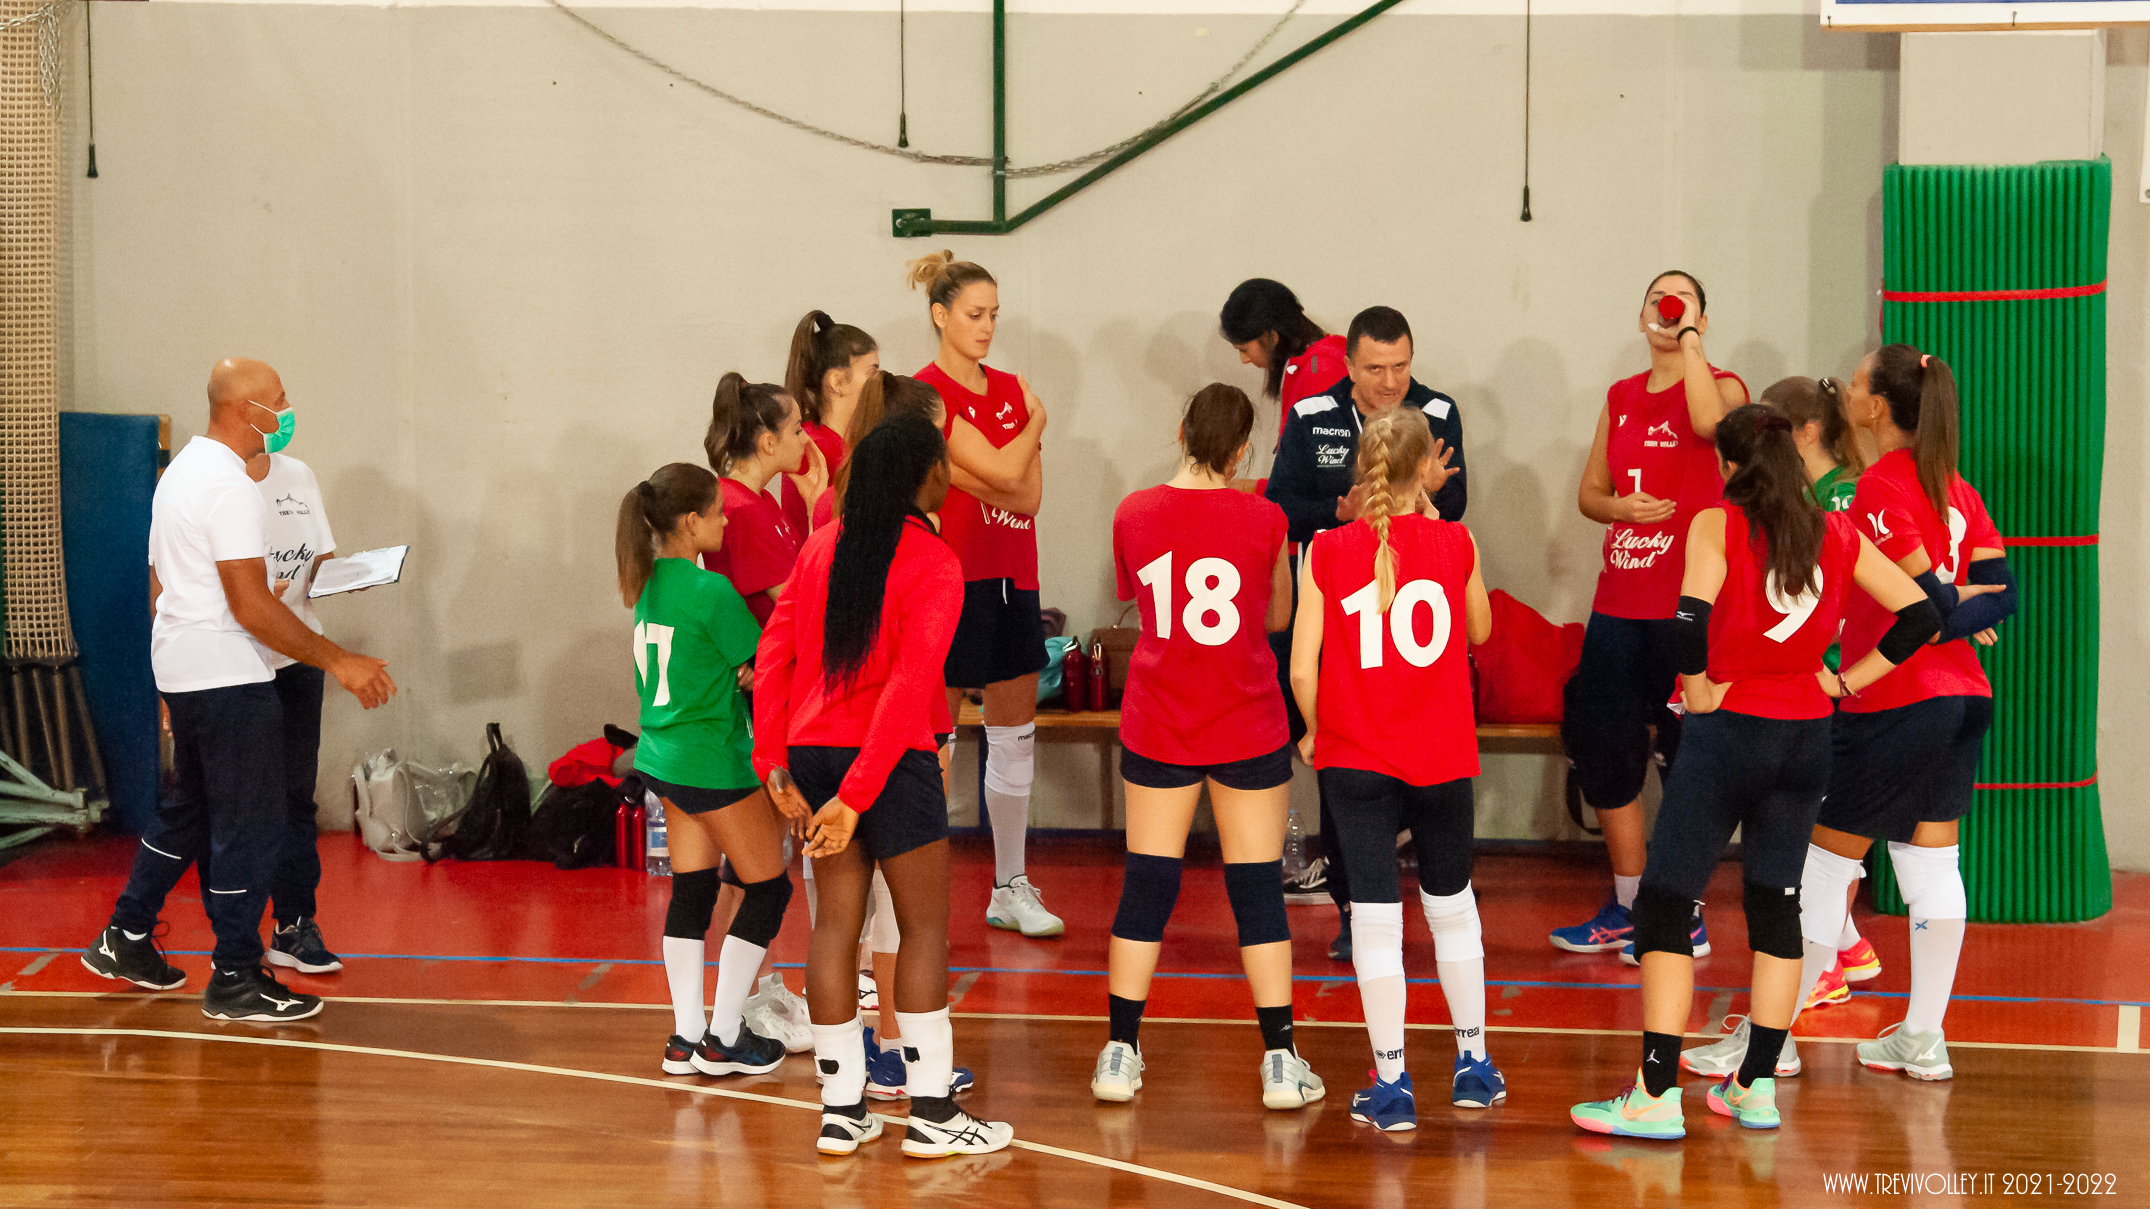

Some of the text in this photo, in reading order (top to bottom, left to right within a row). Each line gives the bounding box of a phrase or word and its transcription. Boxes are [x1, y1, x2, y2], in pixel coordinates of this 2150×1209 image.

[1312, 426, 1351, 437] macron
[1315, 443, 1350, 458] Lucky
[1317, 454, 1344, 464] Wind
[1611, 528, 1675, 555] Lucky
[1610, 549, 1657, 570] Wind
[1136, 550, 1241, 646] 18
[1763, 564, 1824, 644] 9
[1340, 578, 1452, 670] 10
